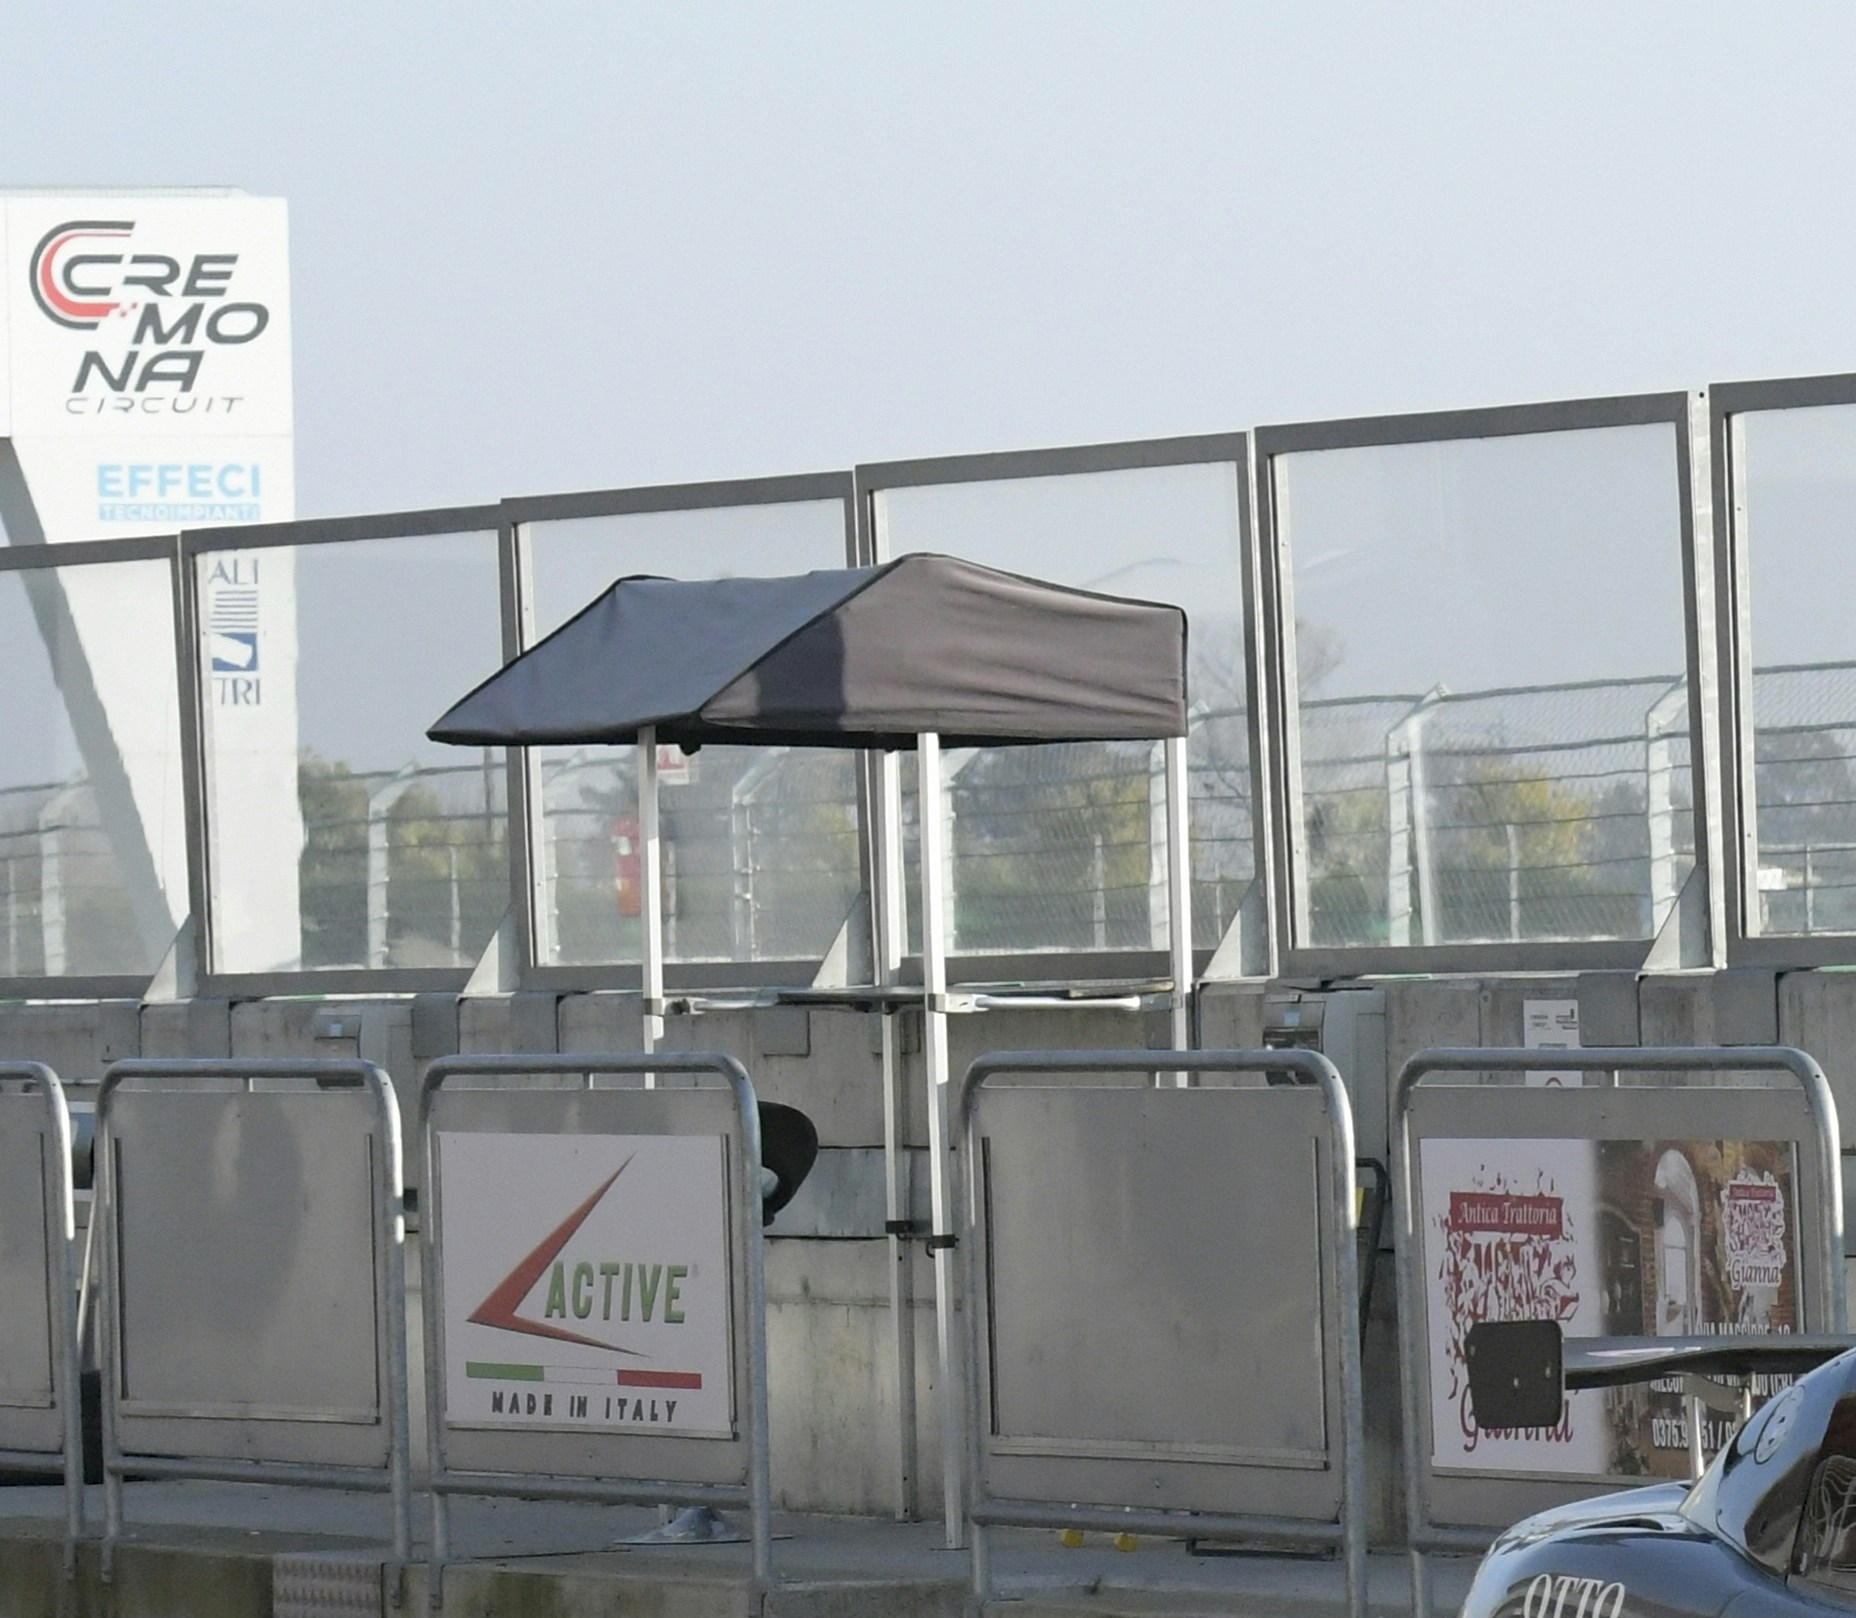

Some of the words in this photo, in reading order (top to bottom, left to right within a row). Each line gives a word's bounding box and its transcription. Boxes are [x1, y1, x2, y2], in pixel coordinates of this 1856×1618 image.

[132, 302, 269, 345] MO
[71, 350, 205, 393] NA
[65, 397, 244, 414] CIRCUIT
[98, 463, 260, 498] EFFECI
[1458, 1202, 1499, 1224] Antica
[1501, 1202, 1557, 1225] Trattoria
[544, 1261, 688, 1325] ACTIVE
[491, 1391, 553, 1418] MADE
[569, 1394, 588, 1419] IN
[605, 1398, 678, 1423] ITALY
